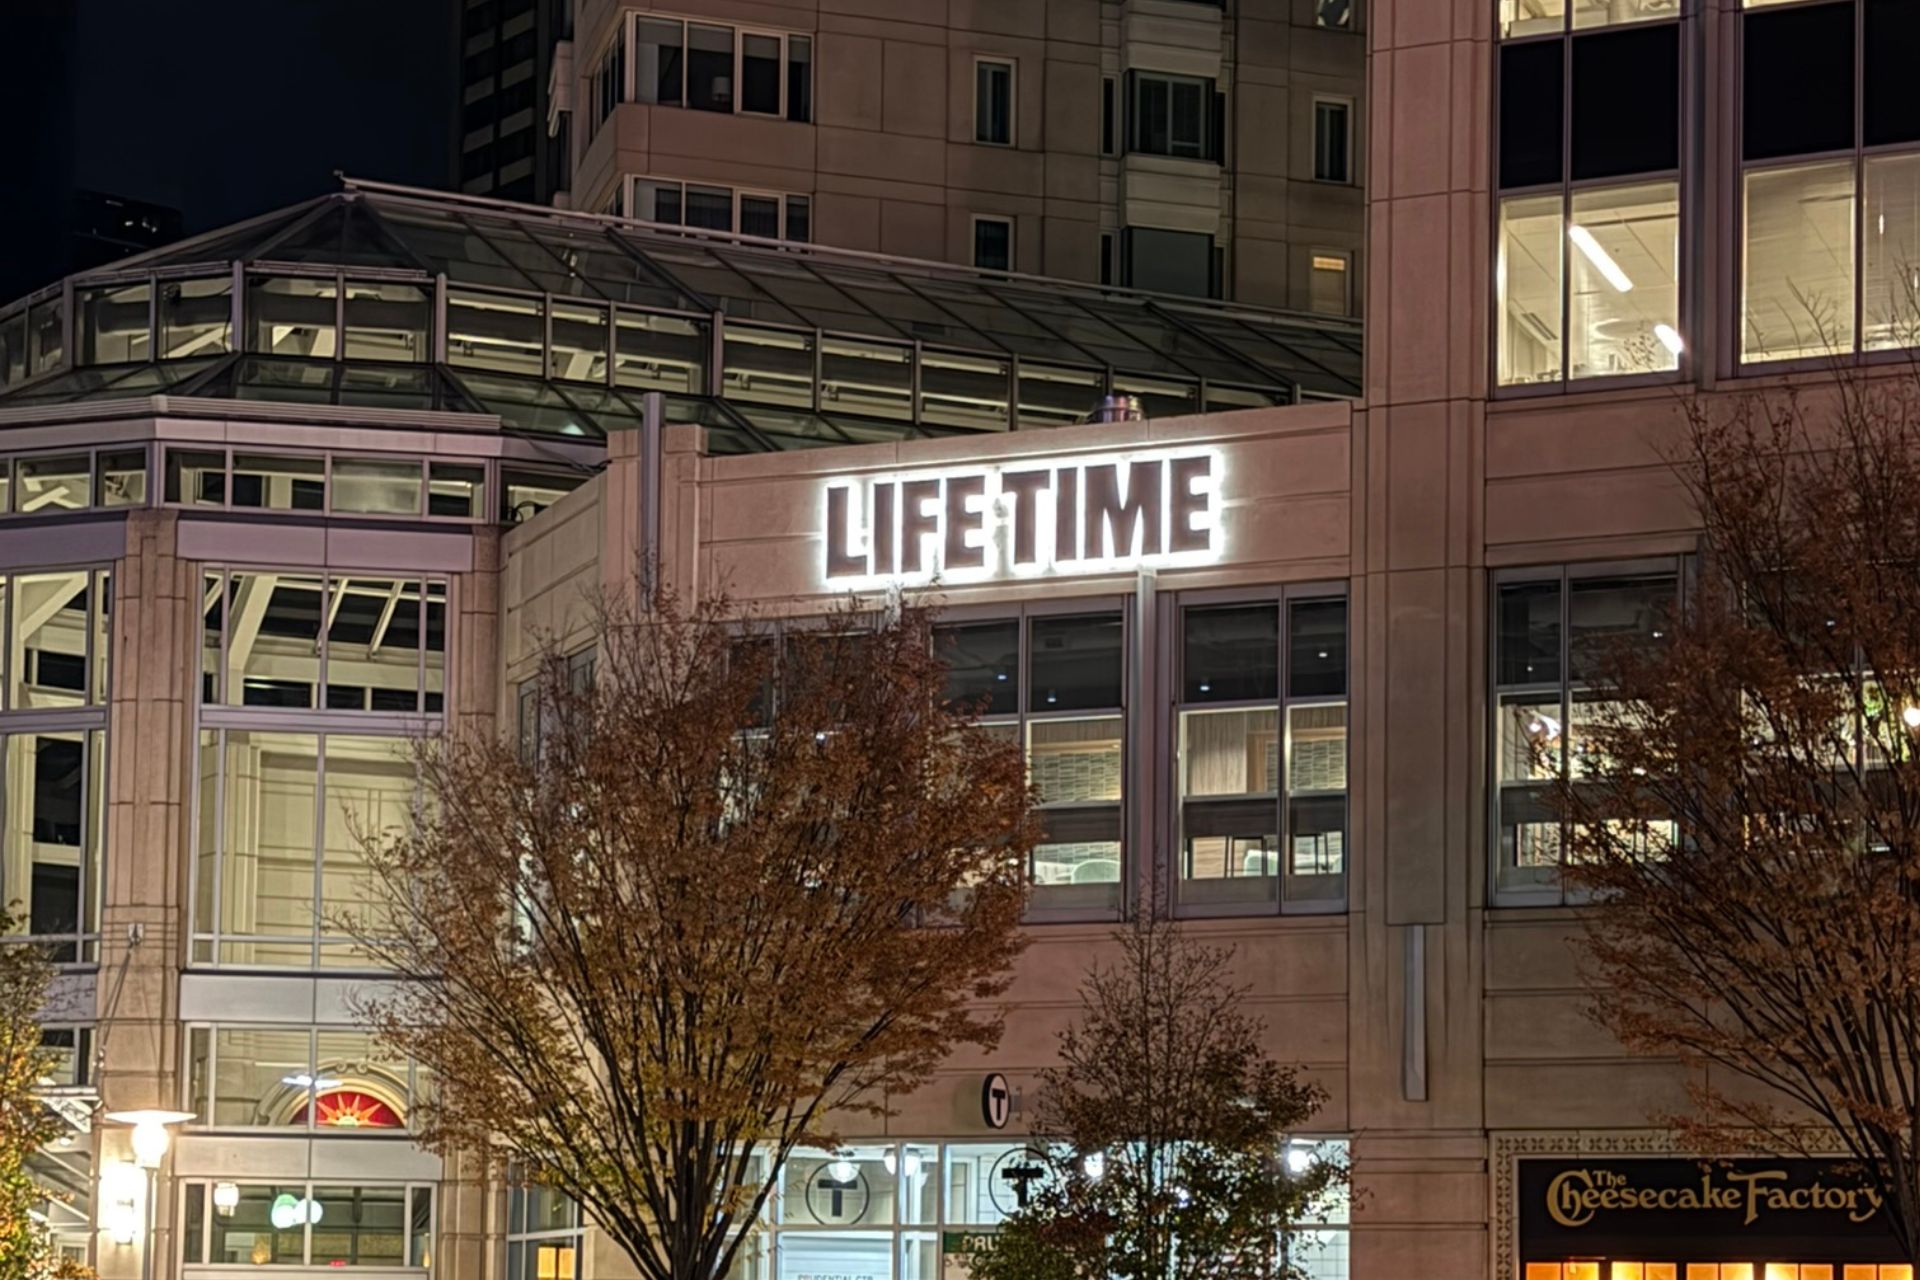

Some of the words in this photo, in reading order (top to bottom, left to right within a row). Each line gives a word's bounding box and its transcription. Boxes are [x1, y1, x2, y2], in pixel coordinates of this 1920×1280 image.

[826, 475, 985, 578] LIFE
[1002, 455, 1212, 565] TIME
[992, 1088, 1006, 1121] T
[817, 1179, 858, 1217] T
[1001, 1168, 1044, 1208] T
[1546, 1169, 1743, 1227] Cheesecake
[1726, 1170, 1883, 1226] Factory
[1592, 1170, 1627, 1188] The
